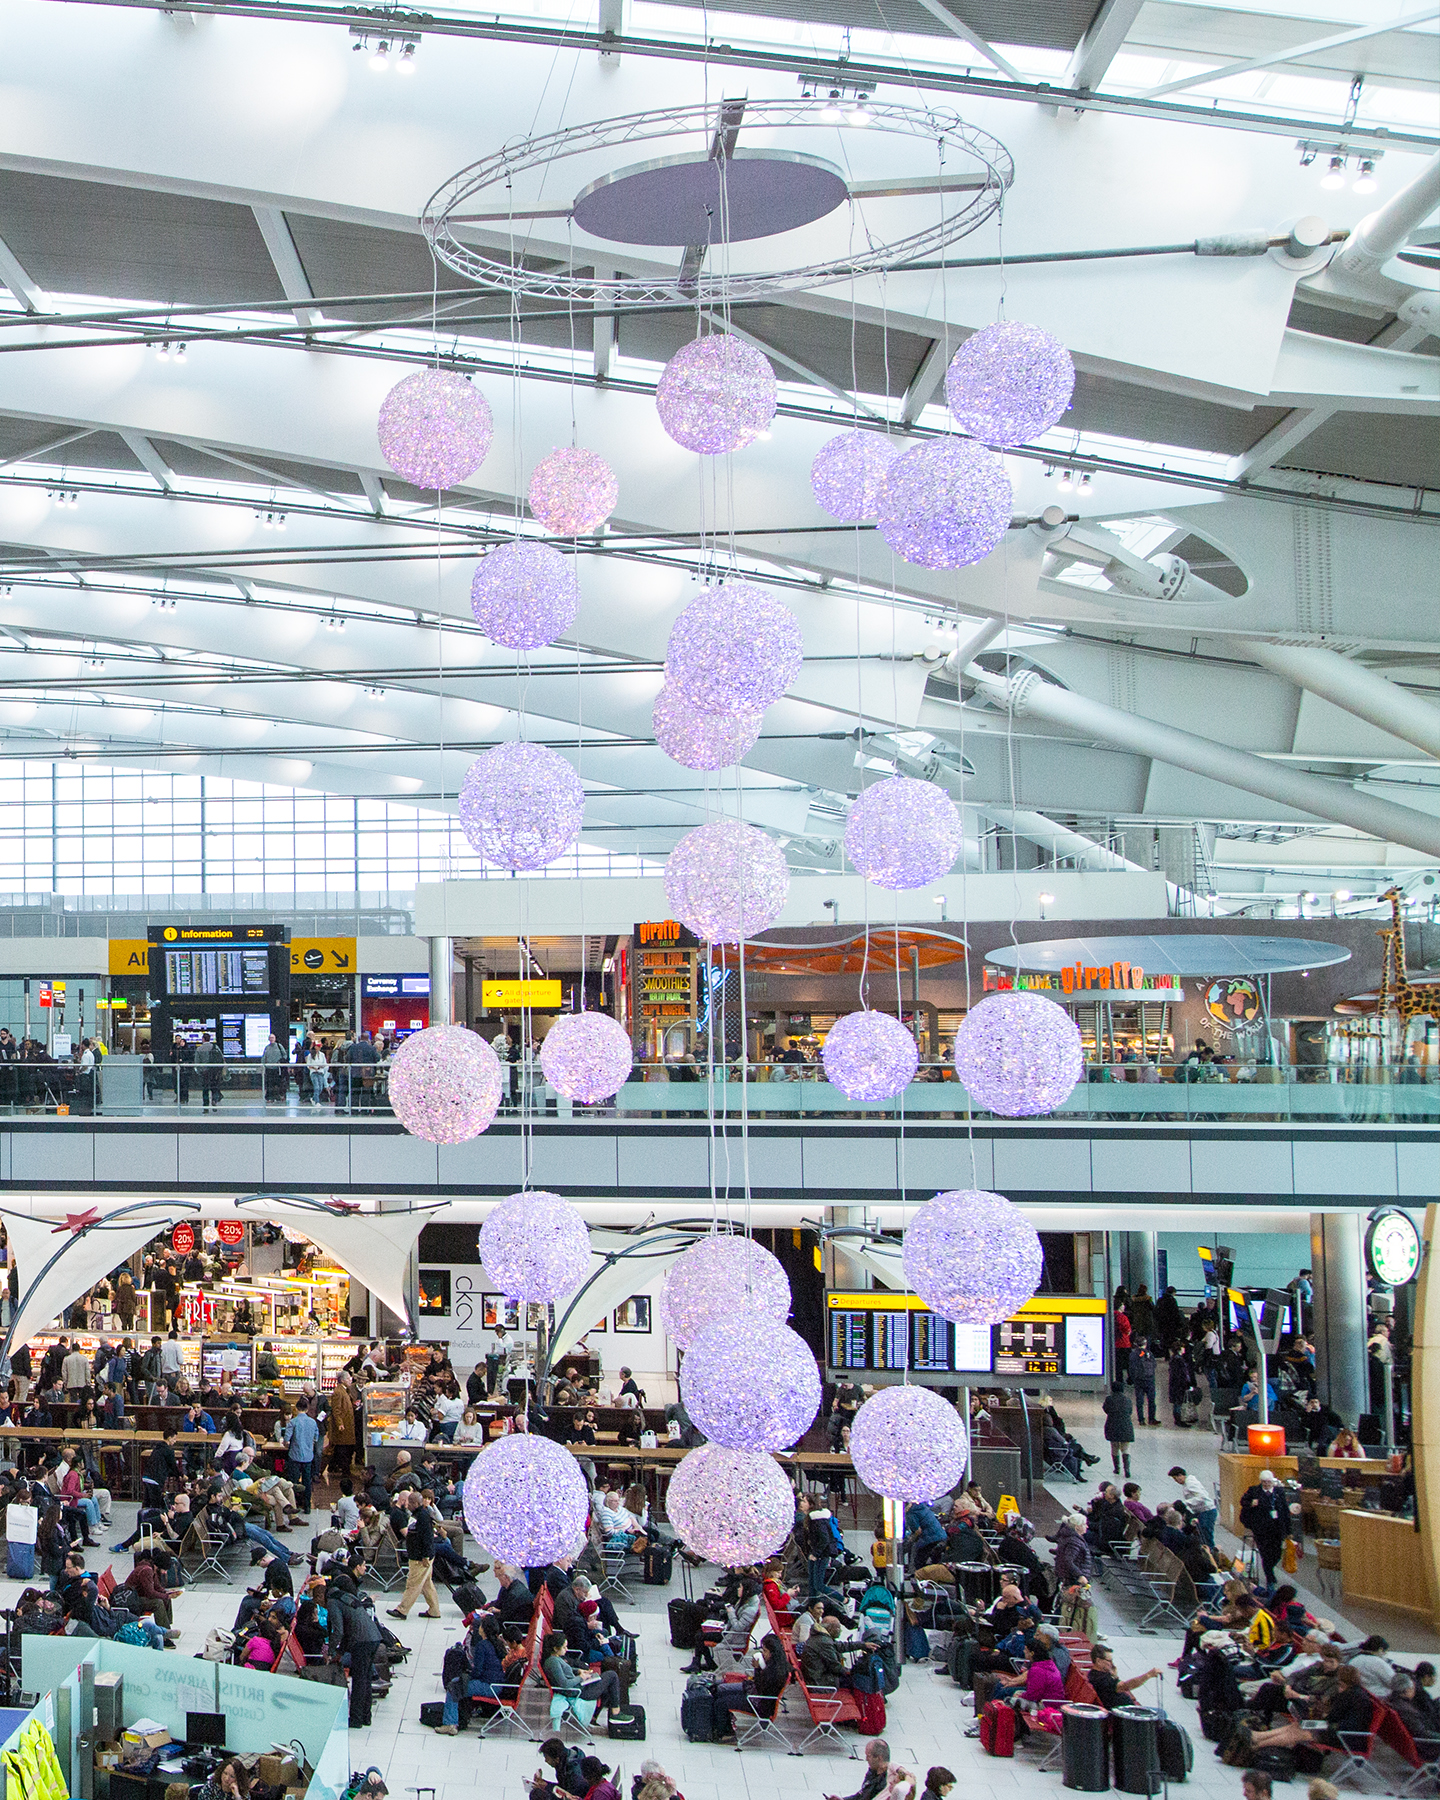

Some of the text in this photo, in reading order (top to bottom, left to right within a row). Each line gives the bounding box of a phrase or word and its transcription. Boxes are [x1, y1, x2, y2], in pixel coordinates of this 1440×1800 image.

[181, 929, 234, 939] Information
[640, 919, 680, 944] giraffe
[127, 951, 149, 967] Al
[367, 977, 398, 986] Currency
[1060, 961, 1144, 994] giraffe
[642, 976, 690, 990] SMOOTHIES
[366, 985, 398, 994] Exchange
[516, 989, 552, 997] departure
[1199, 1017, 1211, 1029] OF
[1213, 1027, 1233, 1040] THE
[220, 1225, 242, 1235] -20%
[175, 1234, 192, 1244] -20%
[840, 1297, 882, 1306] Departures
[184, 1299, 216, 1322] PRET
